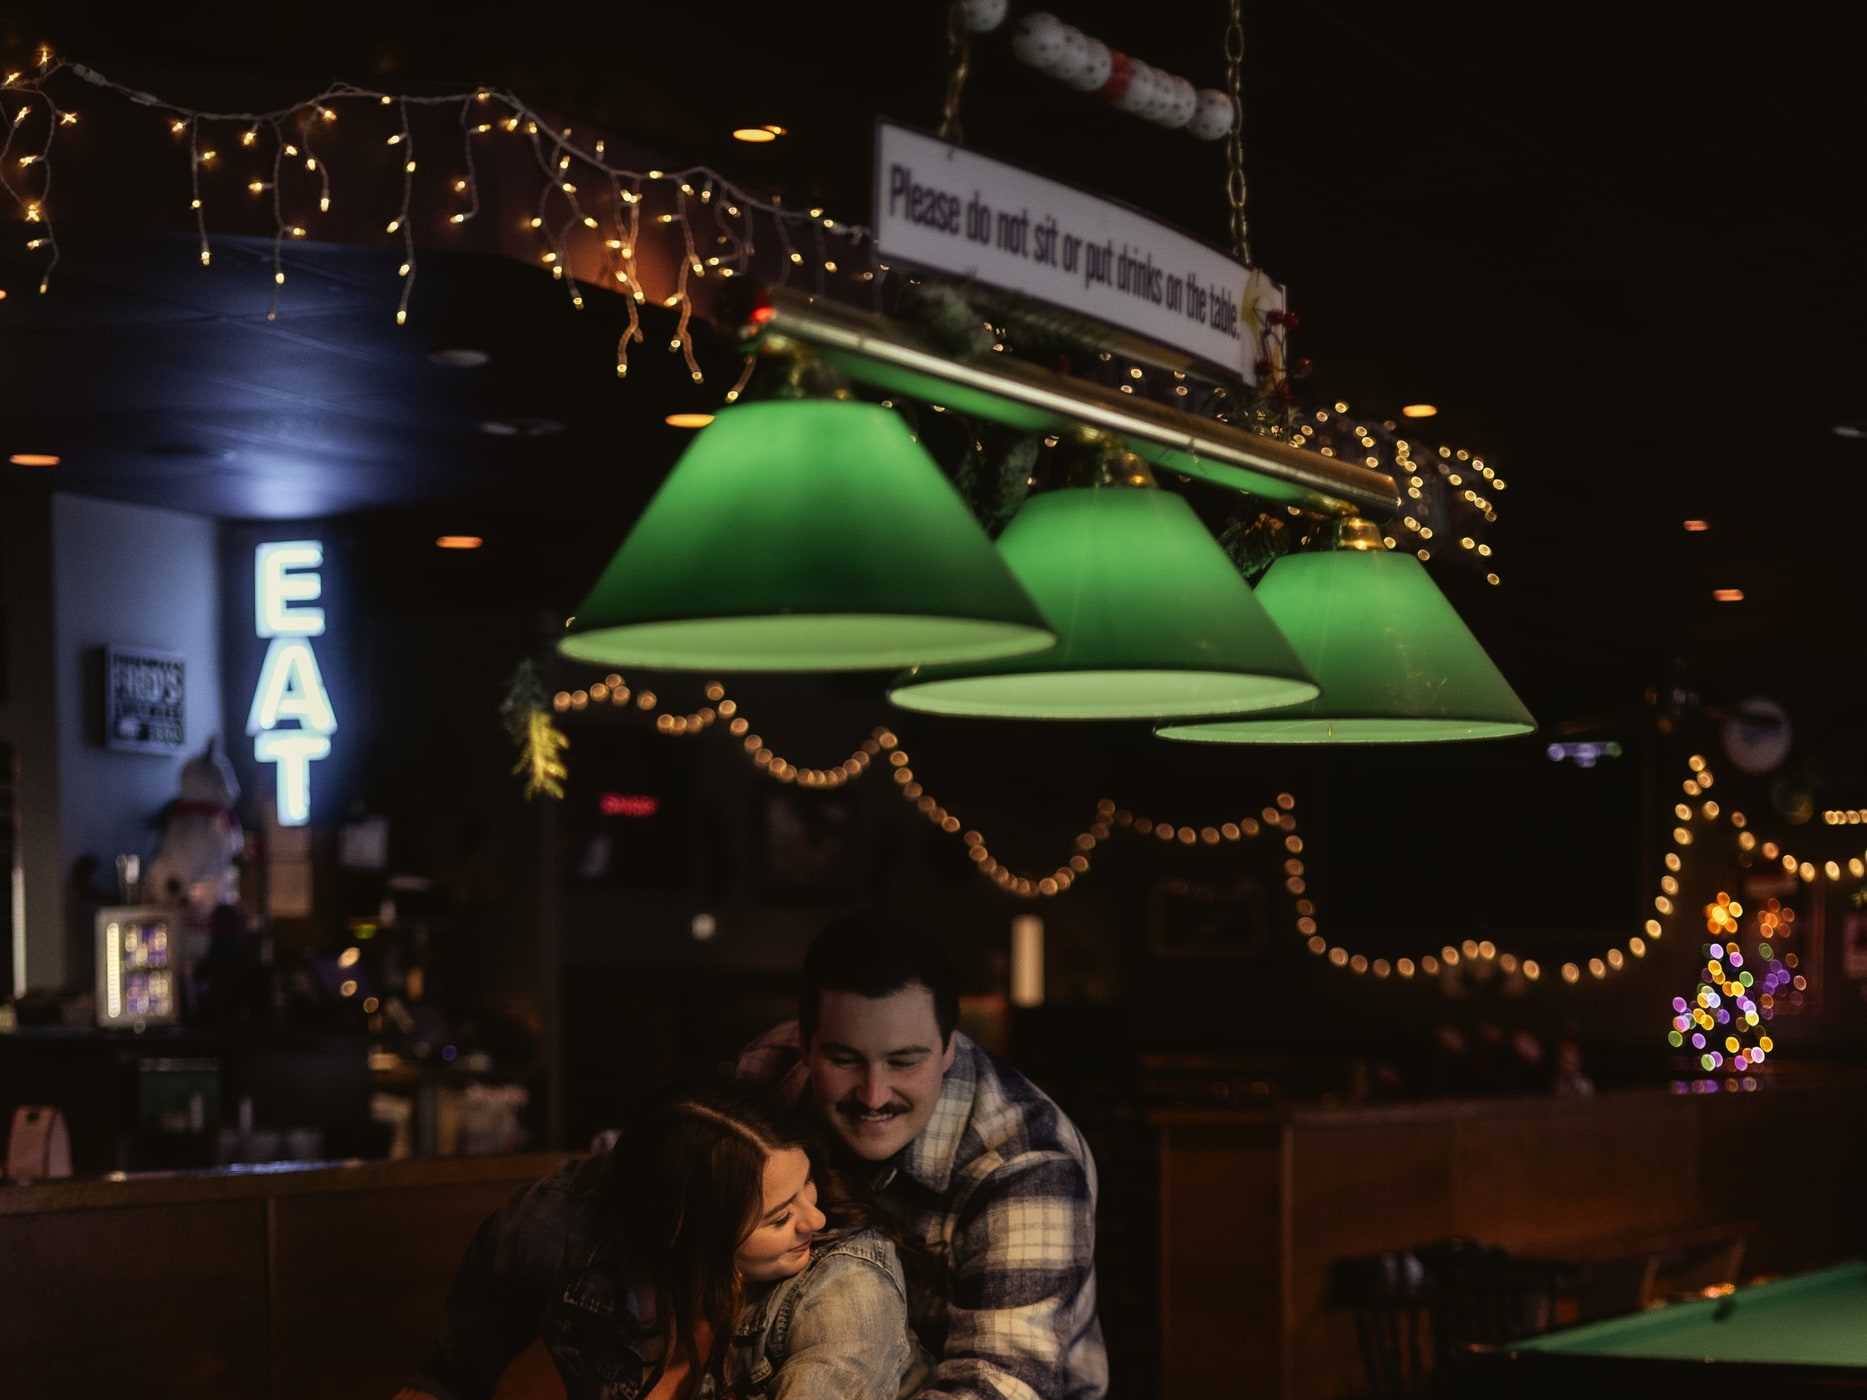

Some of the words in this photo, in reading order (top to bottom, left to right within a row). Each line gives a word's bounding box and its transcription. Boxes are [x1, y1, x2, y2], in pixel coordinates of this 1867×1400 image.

[889, 164, 960, 236] Please
[965, 190, 991, 245] do
[997, 209, 1029, 259] not
[1034, 215, 1058, 269] sit
[1063, 233, 1082, 275] or
[1085, 240, 1113, 291] put
[1117, 243, 1163, 306] drinks
[1166, 273, 1183, 314] on
[1187, 272, 1207, 324] the
[1209, 284, 1241, 341] table.
[245, 540, 338, 827] EAT
